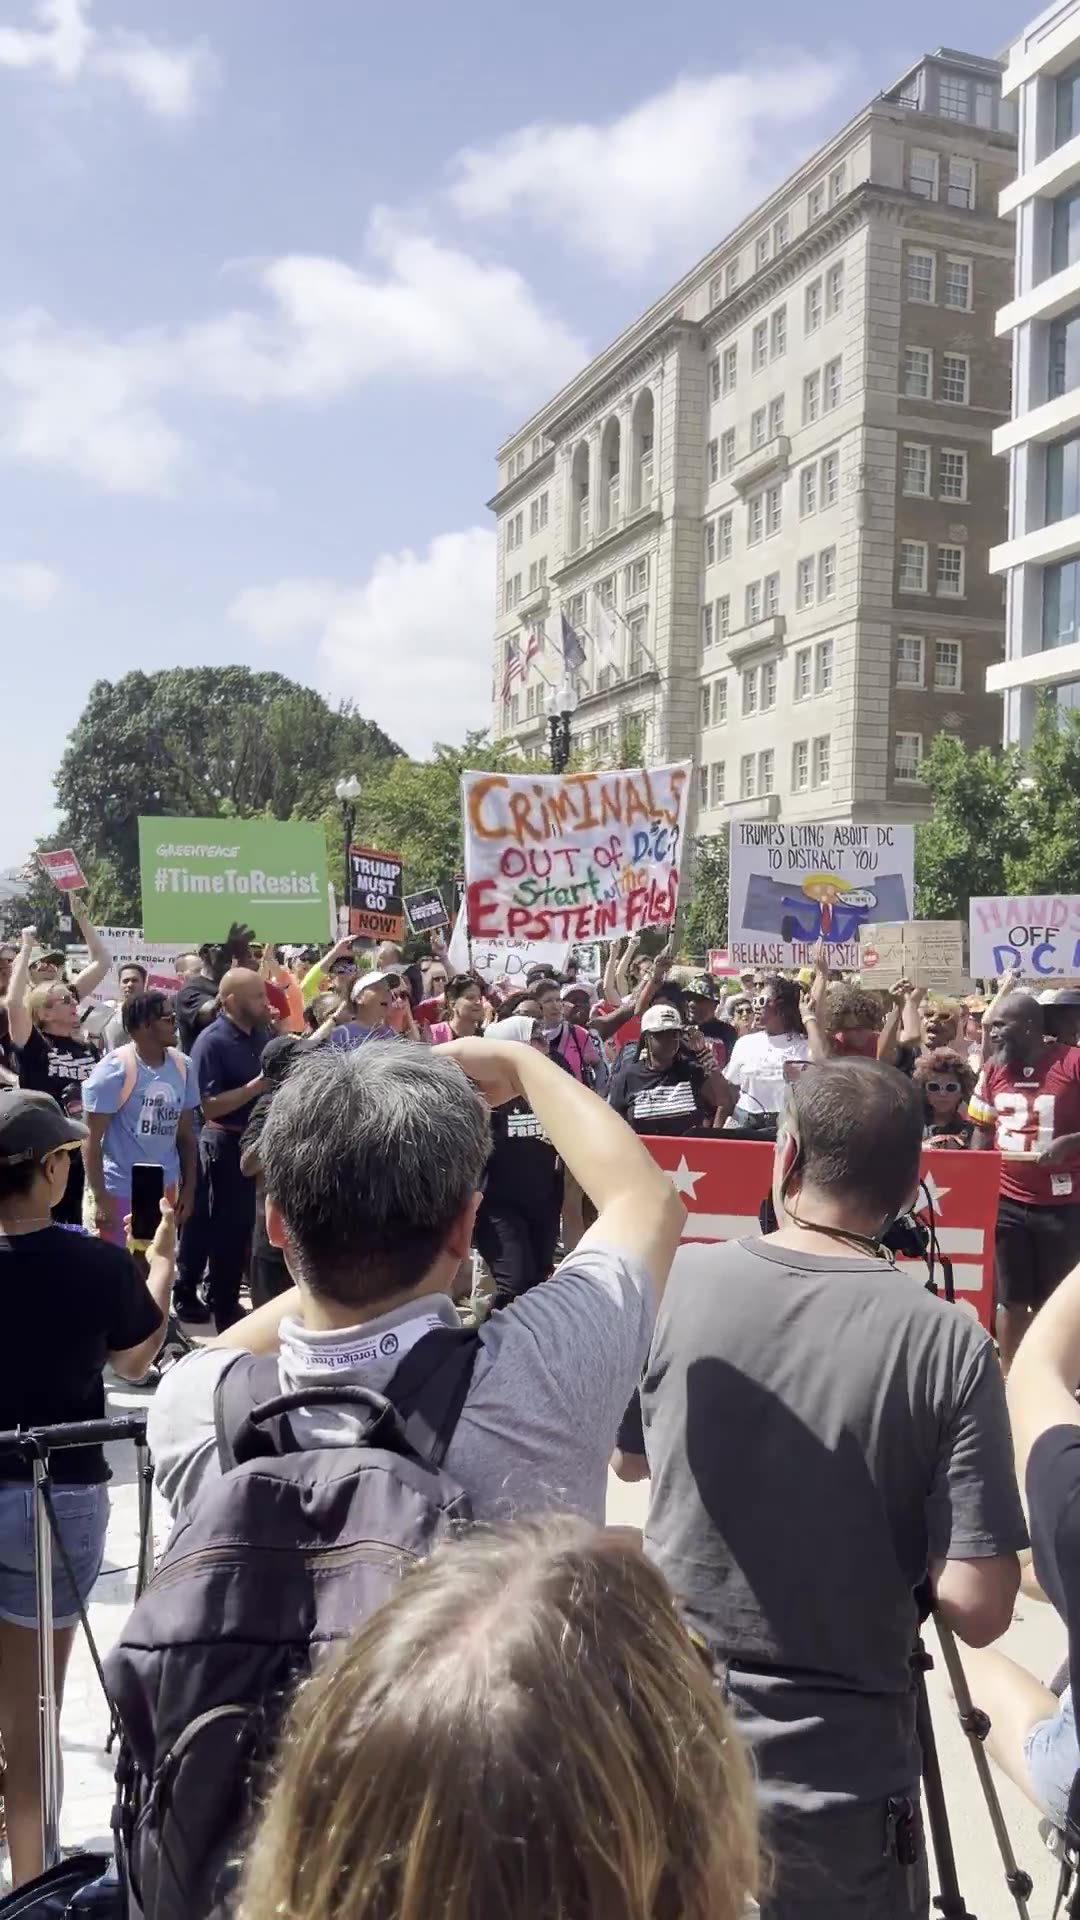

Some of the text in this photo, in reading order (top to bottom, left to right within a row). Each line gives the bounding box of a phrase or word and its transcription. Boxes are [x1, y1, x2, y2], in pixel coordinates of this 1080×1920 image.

[790, 825, 824, 847] LYING
[833, 826, 869, 846] ABOUT
[877, 826, 895, 846] DC
[156, 844, 241, 859] GREENPEACE
[500, 847, 581, 878] OUT
[767, 849, 878, 870] TO DISTRACT YOU
[352, 857, 401, 879] TRUMP
[154, 868, 320, 893] #TimeToResist
[356, 874, 396, 896] MUST
[365, 893, 387, 911] GO
[359, 914, 397, 933] NOW!
[1008, 925, 1060, 947] OFF
[732, 943, 784, 964] RELEASE
[791, 942, 814, 965] THE
[157, 1107, 180, 1121] Kids
[993, 1092, 1056, 1152] 21
[336, 1348, 377, 1364] Foreign
